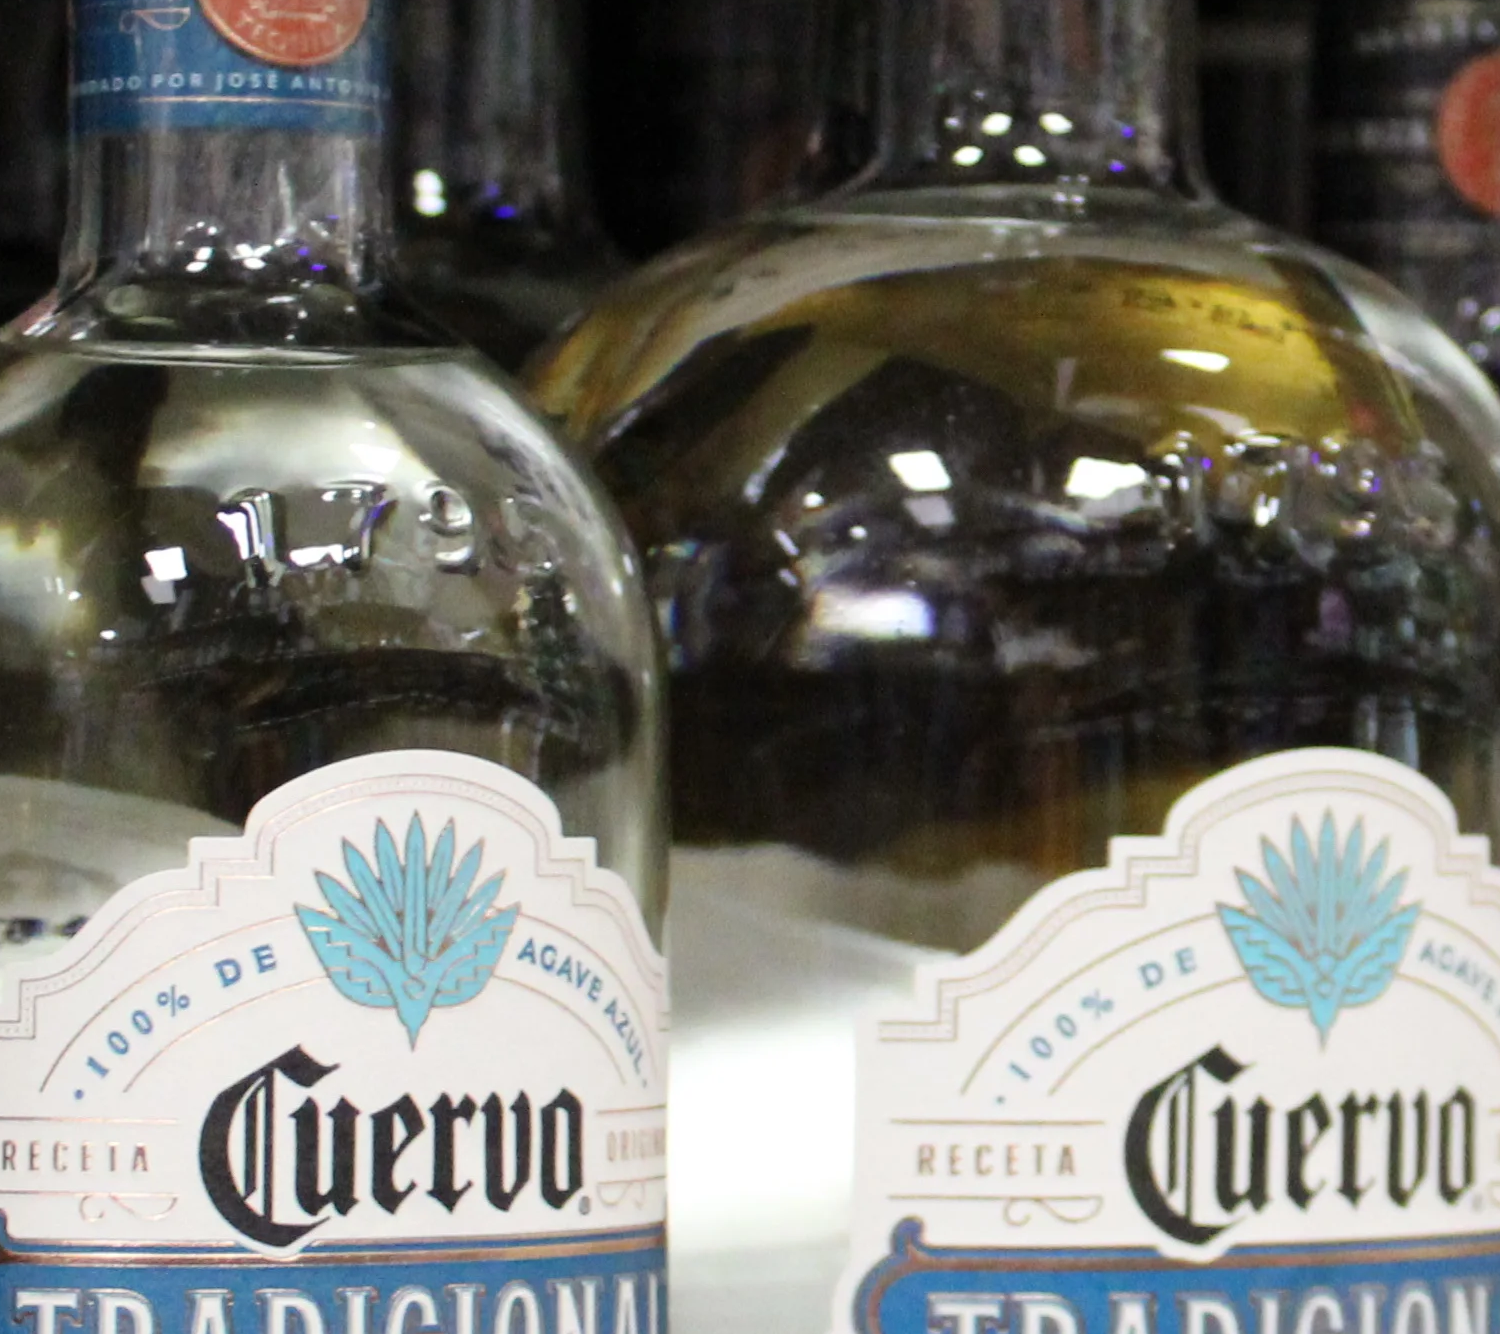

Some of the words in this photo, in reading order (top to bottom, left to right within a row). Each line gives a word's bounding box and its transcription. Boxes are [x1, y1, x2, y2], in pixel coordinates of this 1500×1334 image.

[85, 984, 191, 1079] 100%
[212, 944, 278, 989] DE
[516, 937, 604, 1003] AGAVE
[1008, 989, 1116, 1083] 100%
[1138, 946, 1198, 989] DE
[2, 1139, 149, 1174] RECETA
[197, 1043, 585, 1249] Cuervo
[916, 1143, 1077, 1177] RECETA
[1123, 1043, 1479, 1247] Cuervo
